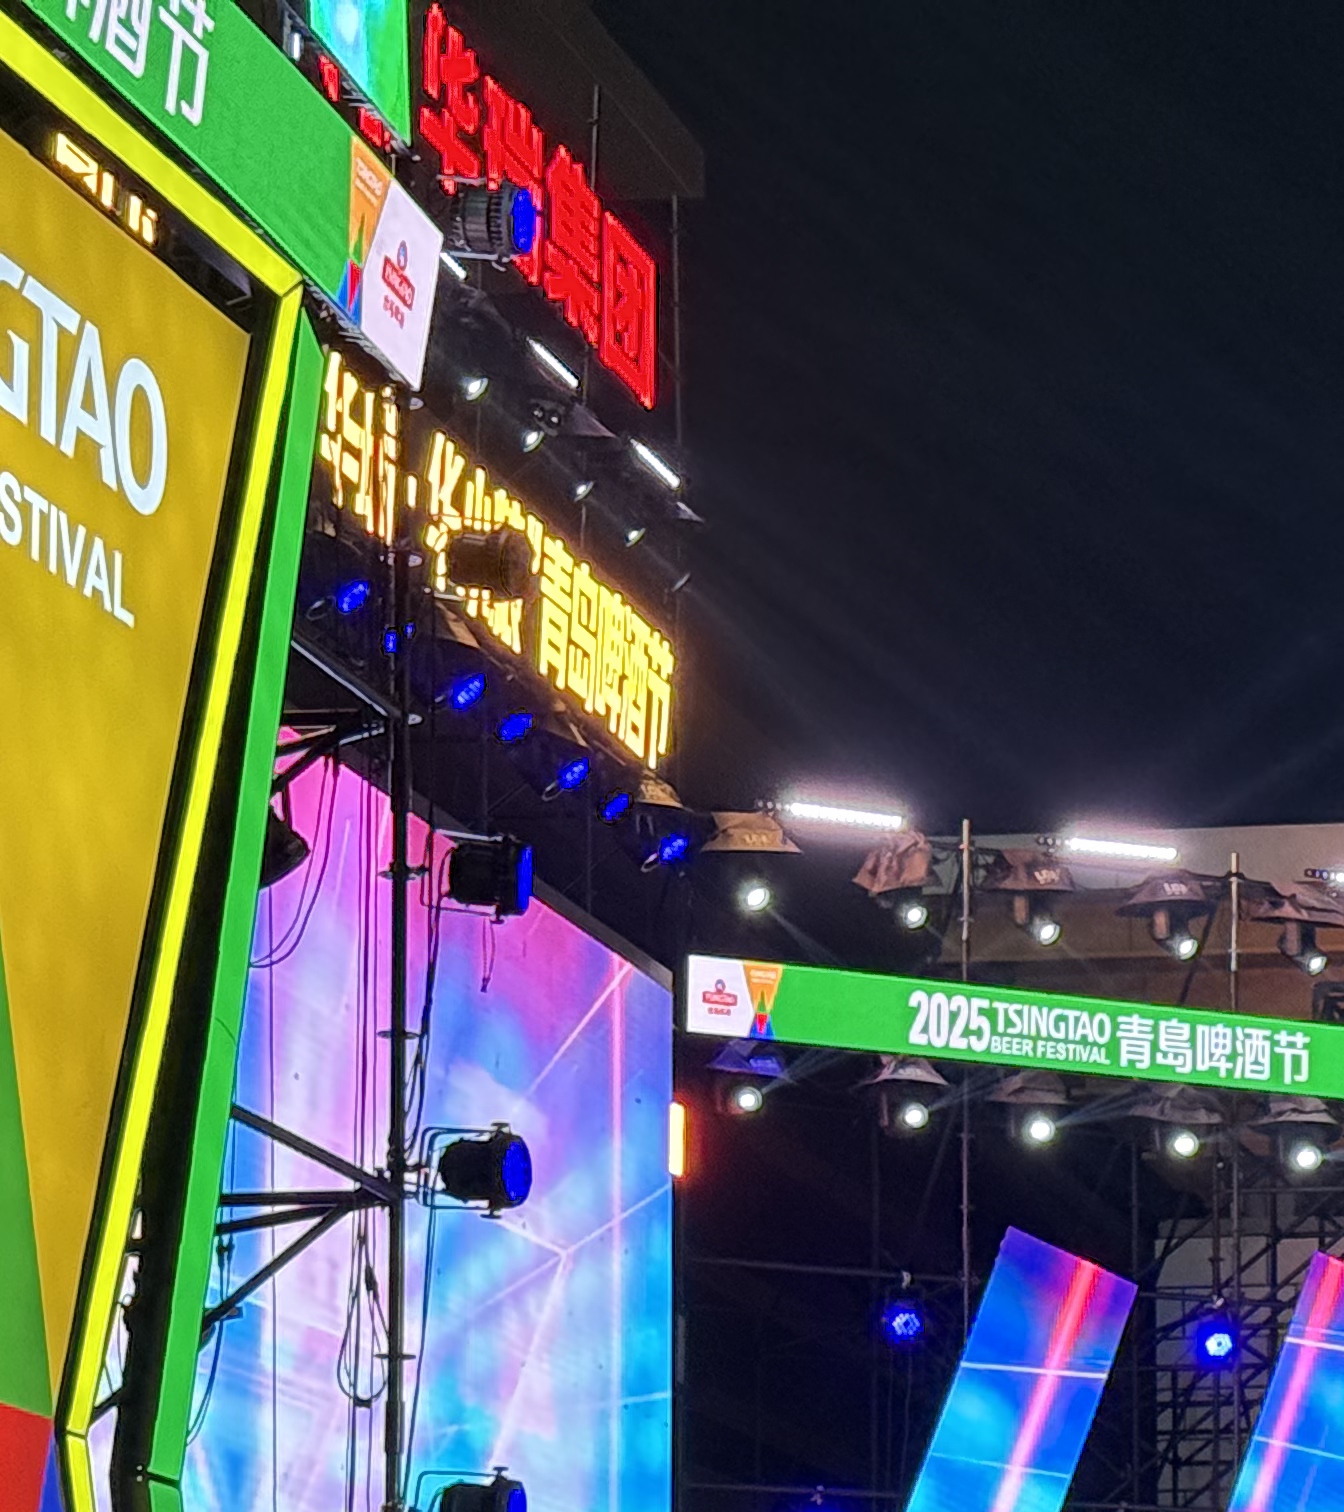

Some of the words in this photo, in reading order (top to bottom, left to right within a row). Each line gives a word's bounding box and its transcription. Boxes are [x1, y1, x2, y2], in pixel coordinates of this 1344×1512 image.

[908, 989, 991, 1053] 2025
[991, 1001, 1112, 1045] TSINGTAO
[990, 1036, 1034, 1057] BEER
[1036, 1039, 1111, 1066] FESTIVAL
